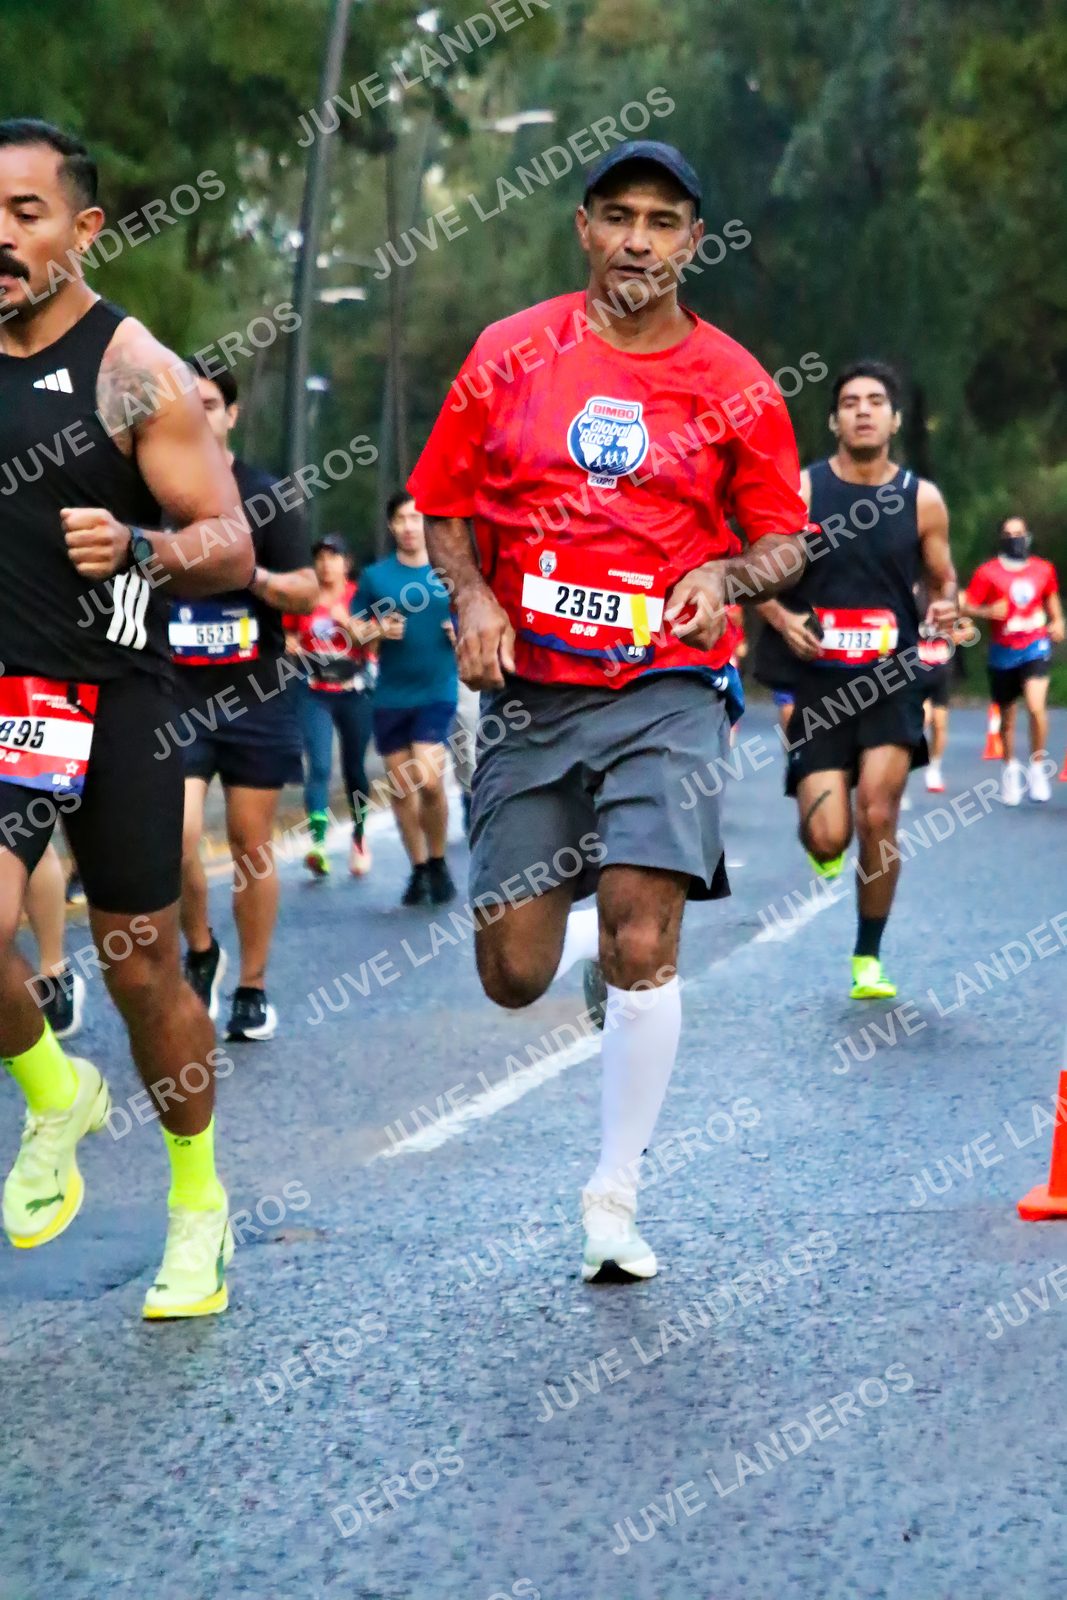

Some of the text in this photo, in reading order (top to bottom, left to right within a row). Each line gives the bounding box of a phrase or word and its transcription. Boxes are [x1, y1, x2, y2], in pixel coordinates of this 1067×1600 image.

[593, 404, 634, 419] BIMBO
[590, 419, 632, 438] Global
[579, 429, 614, 447] Race
[555, 586, 620, 622] 2353
[196, 625, 234, 644] 5523
[838, 633, 871, 648] 2732
[628, 646, 644, 657] 5K
